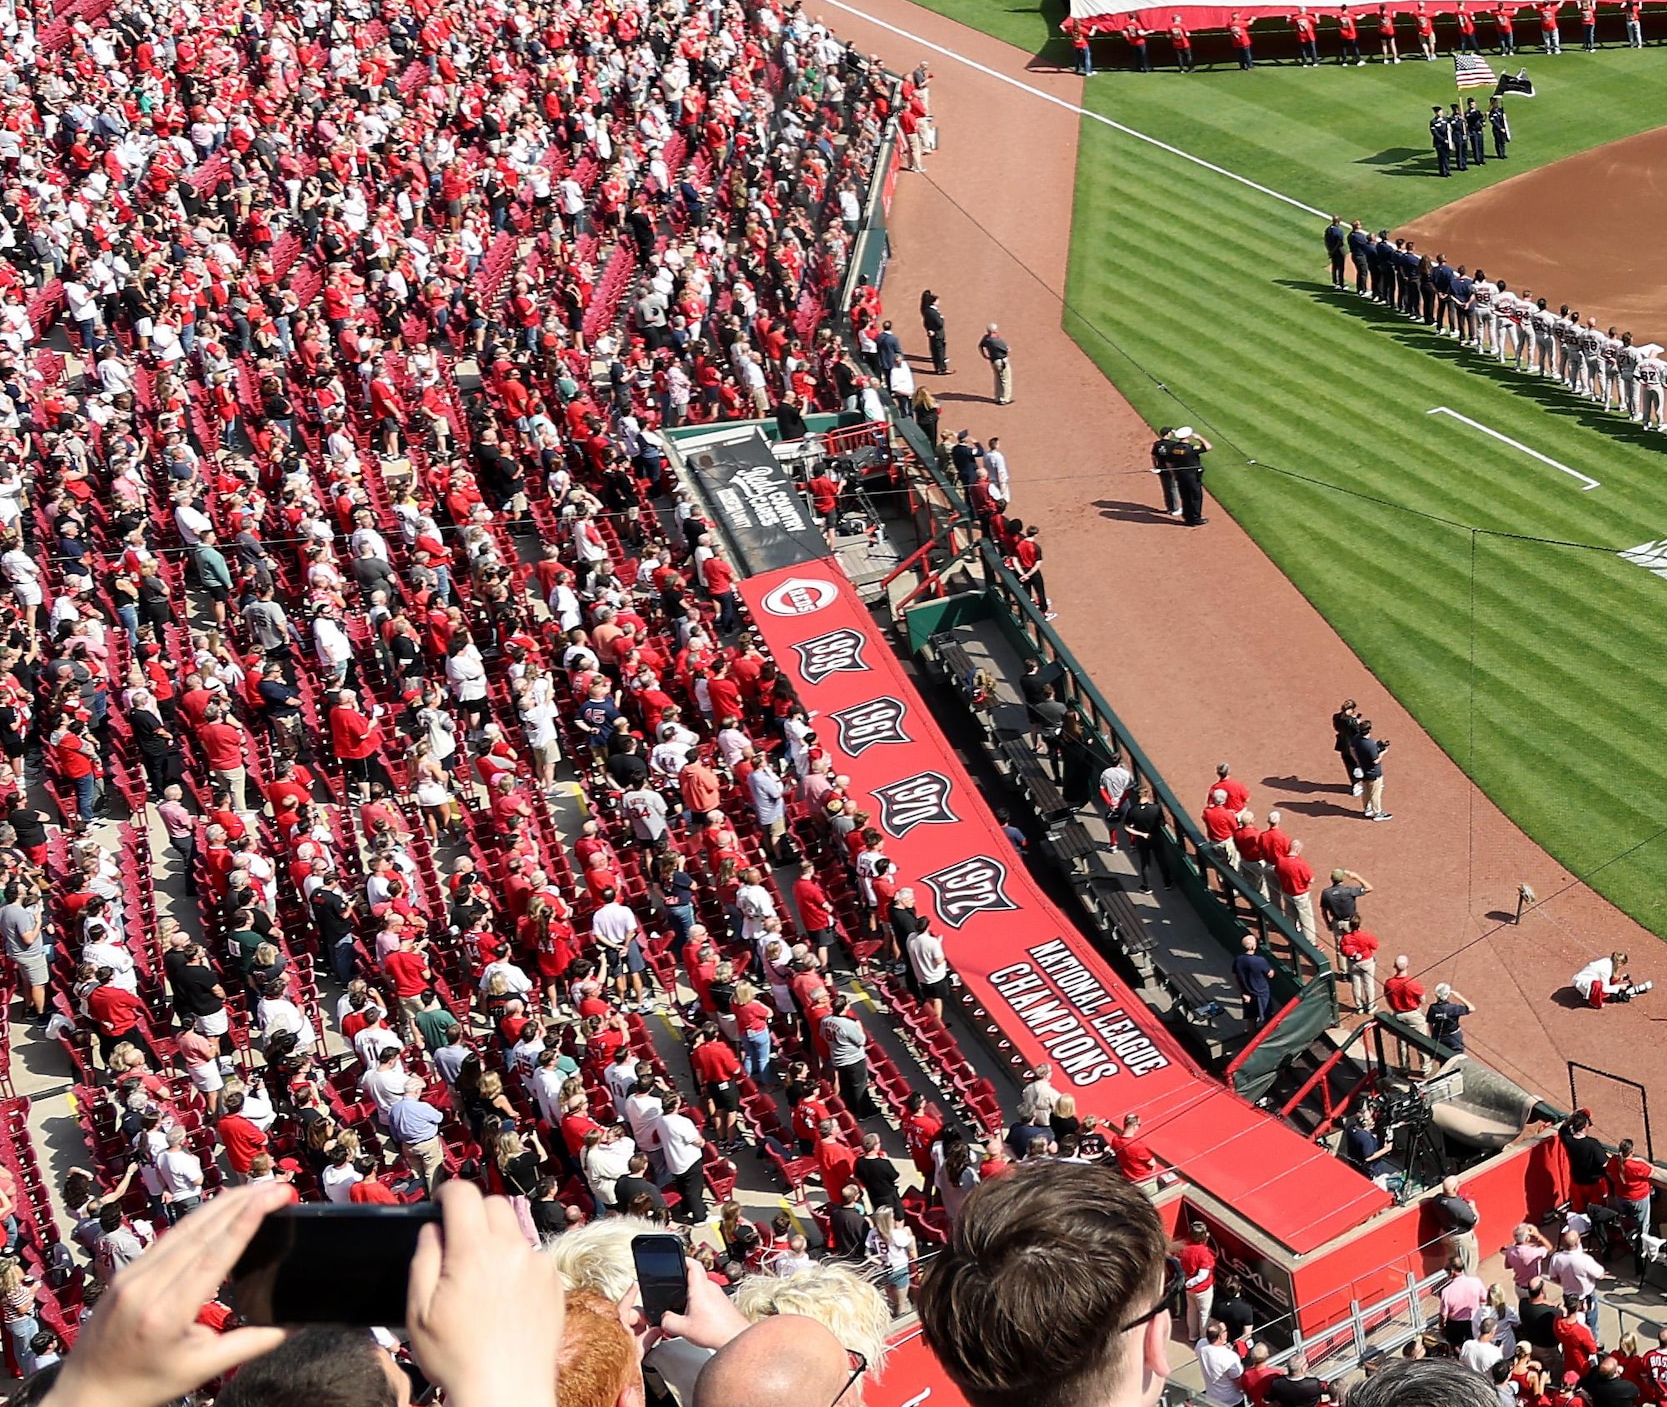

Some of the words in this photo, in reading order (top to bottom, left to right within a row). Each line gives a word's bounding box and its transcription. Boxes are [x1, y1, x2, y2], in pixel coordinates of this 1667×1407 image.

[729, 465, 788, 500] Reds
[768, 491, 807, 532] COUNTRY
[748, 495, 780, 527] CARES
[788, 587, 816, 614] REDS
[845, 702, 895, 745] 1961
[886, 776, 938, 827] 1970
[936, 861, 997, 916] 1972
[987, 962, 1119, 1087] CHAMPIONS
[1027, 938, 1115, 1017] NATIONAL
[1089, 1008, 1171, 1077] LEAGUE
[1220, 1247, 1289, 1307] LEXUS
